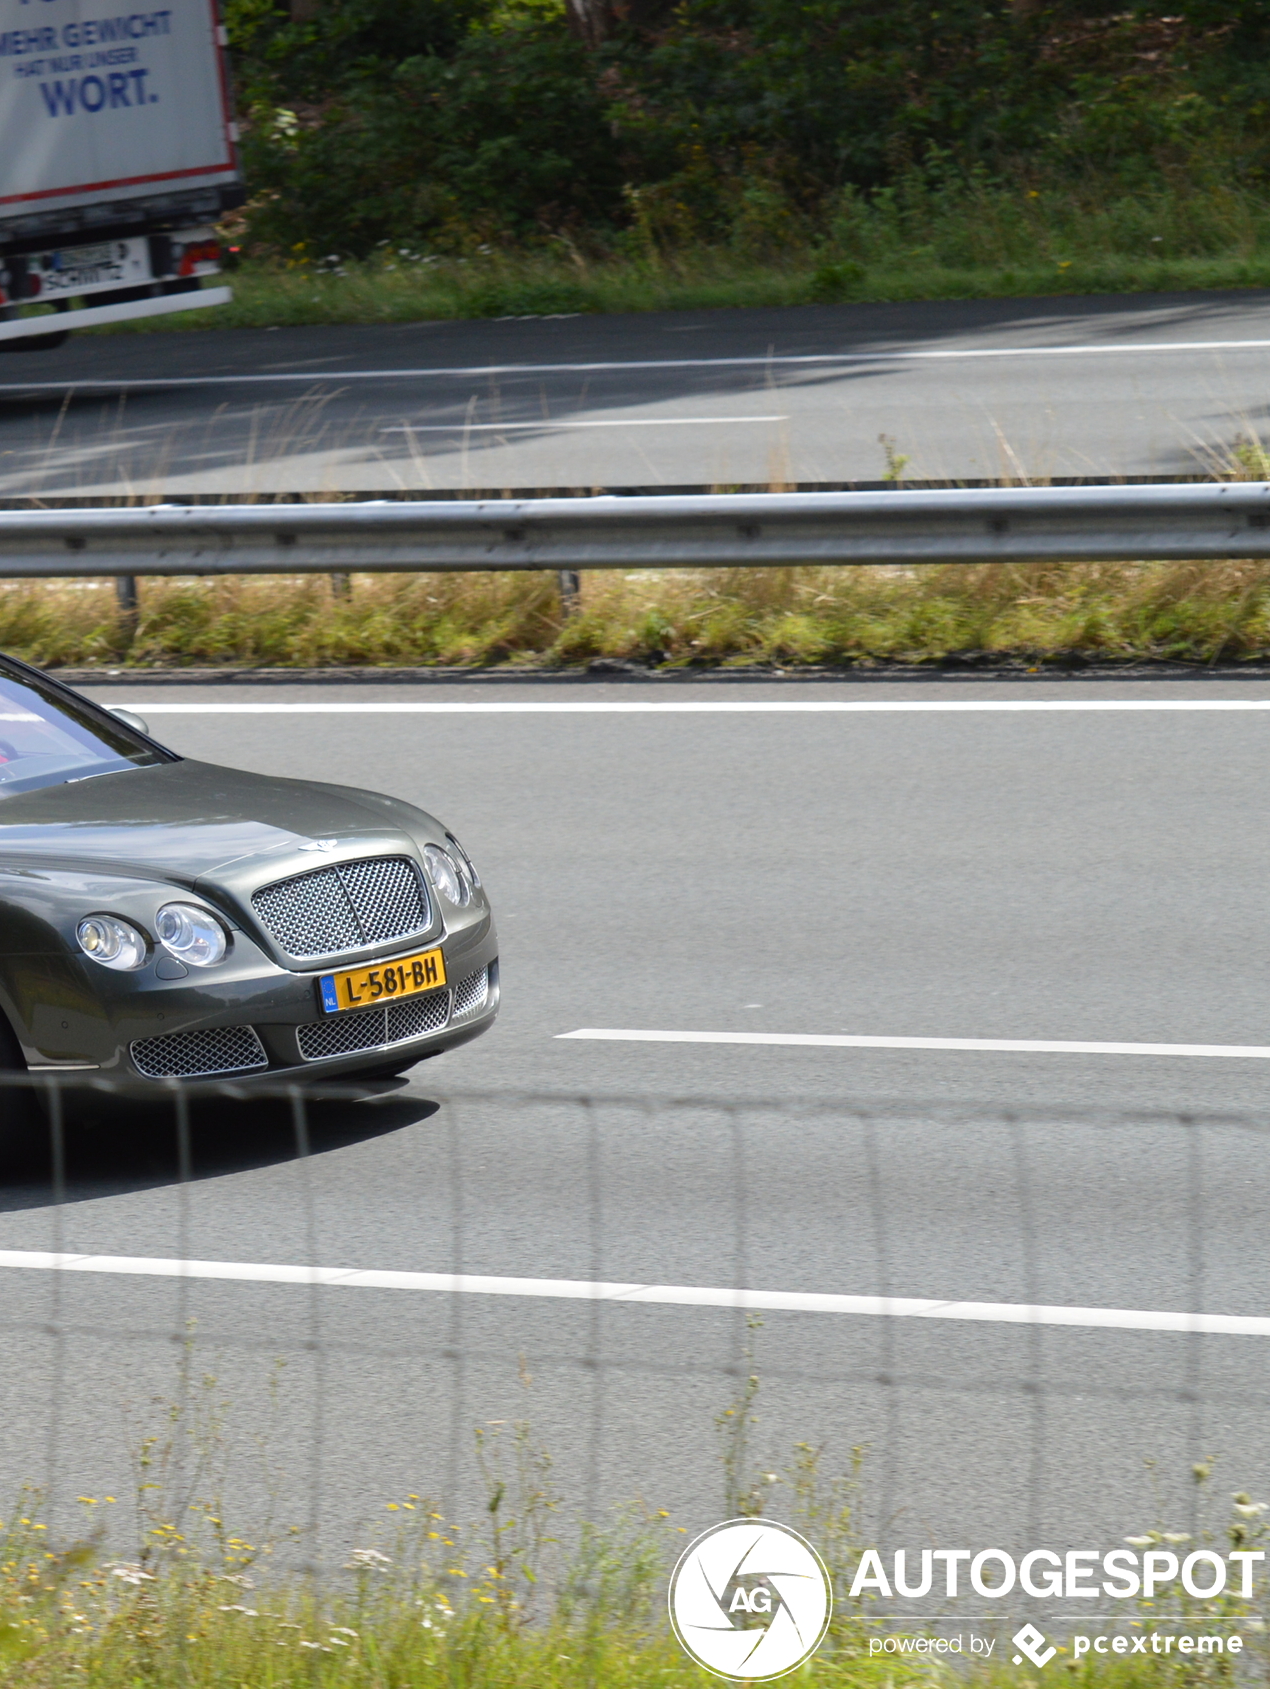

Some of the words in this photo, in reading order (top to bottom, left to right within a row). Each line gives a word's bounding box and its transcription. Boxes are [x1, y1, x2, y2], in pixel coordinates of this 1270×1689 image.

[61, 10, 173, 47] GEWICHT
[39, 68, 160, 118] WORT.
[346, 956, 438, 1003] L-581-BH
[325, 998, 337, 1007] NL
